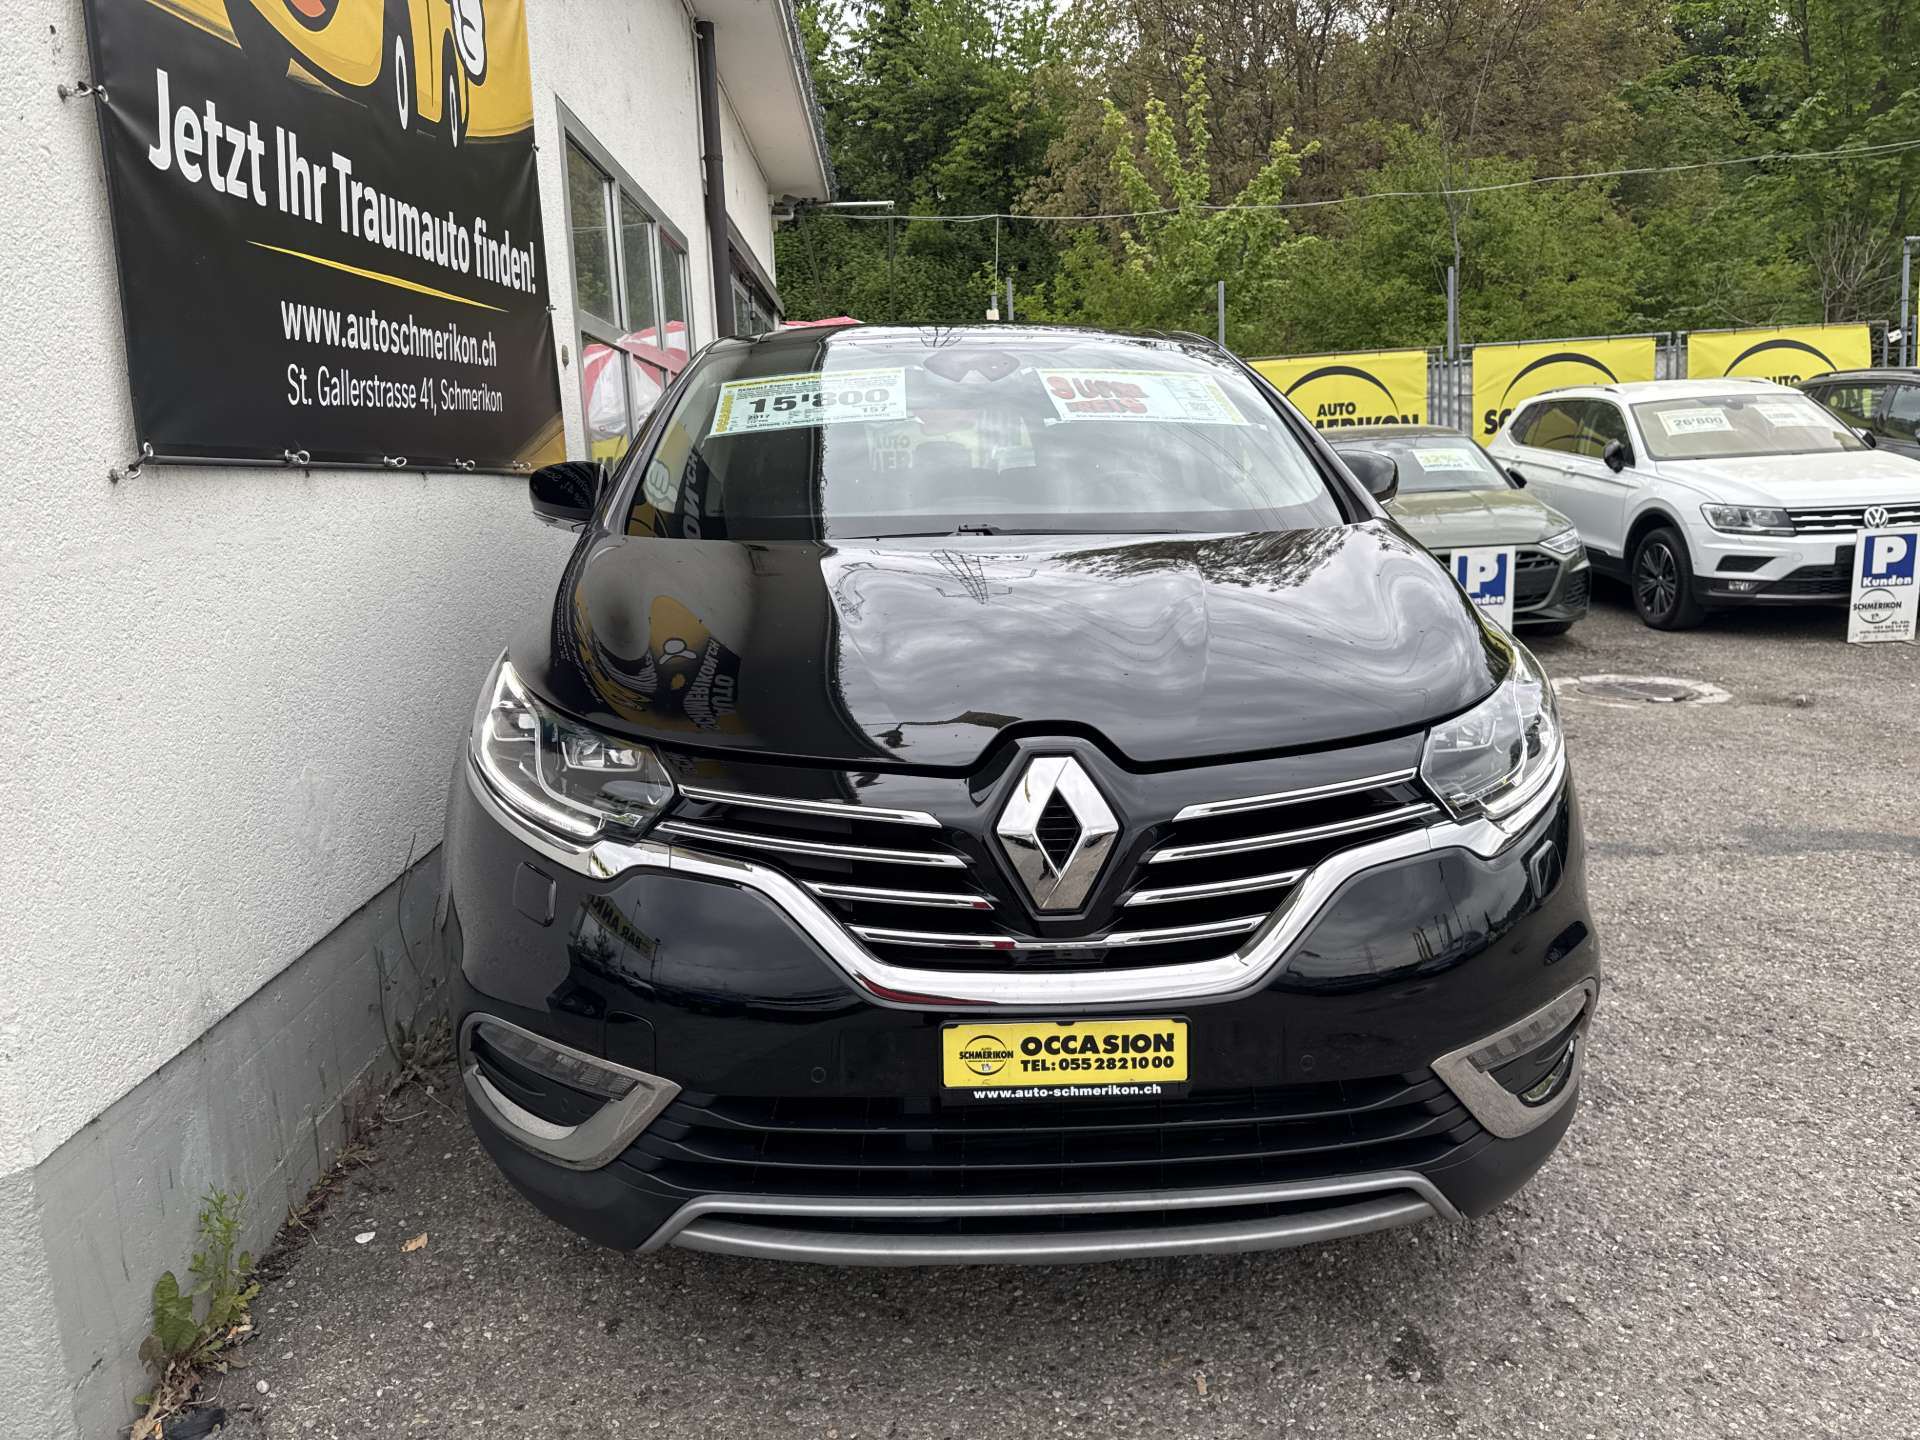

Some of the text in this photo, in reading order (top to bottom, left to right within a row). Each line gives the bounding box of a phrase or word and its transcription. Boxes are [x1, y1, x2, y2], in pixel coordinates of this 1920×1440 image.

[148, 67, 537, 295] Jetzt Ihr Traumauto finden!
[281, 300, 498, 368] www.autoschmerikon.ch
[287, 363, 504, 417] St. Gallerstrasse 41, Schmerikon
[750, 388, 890, 414] 15'800
[1317, 402, 1357, 417] AUTO
[1862, 574, 1913, 588] Kunden
[1853, 601, 1902, 611] SCHMERIKON
[1020, 1033, 1175, 1056] OCCASION
[959, 1050, 1014, 1060] SCHMERIKON
[1020, 1059, 1056, 1073] TEL:
[973, 1084, 1162, 1100] www.auto-schmerikon.ch
